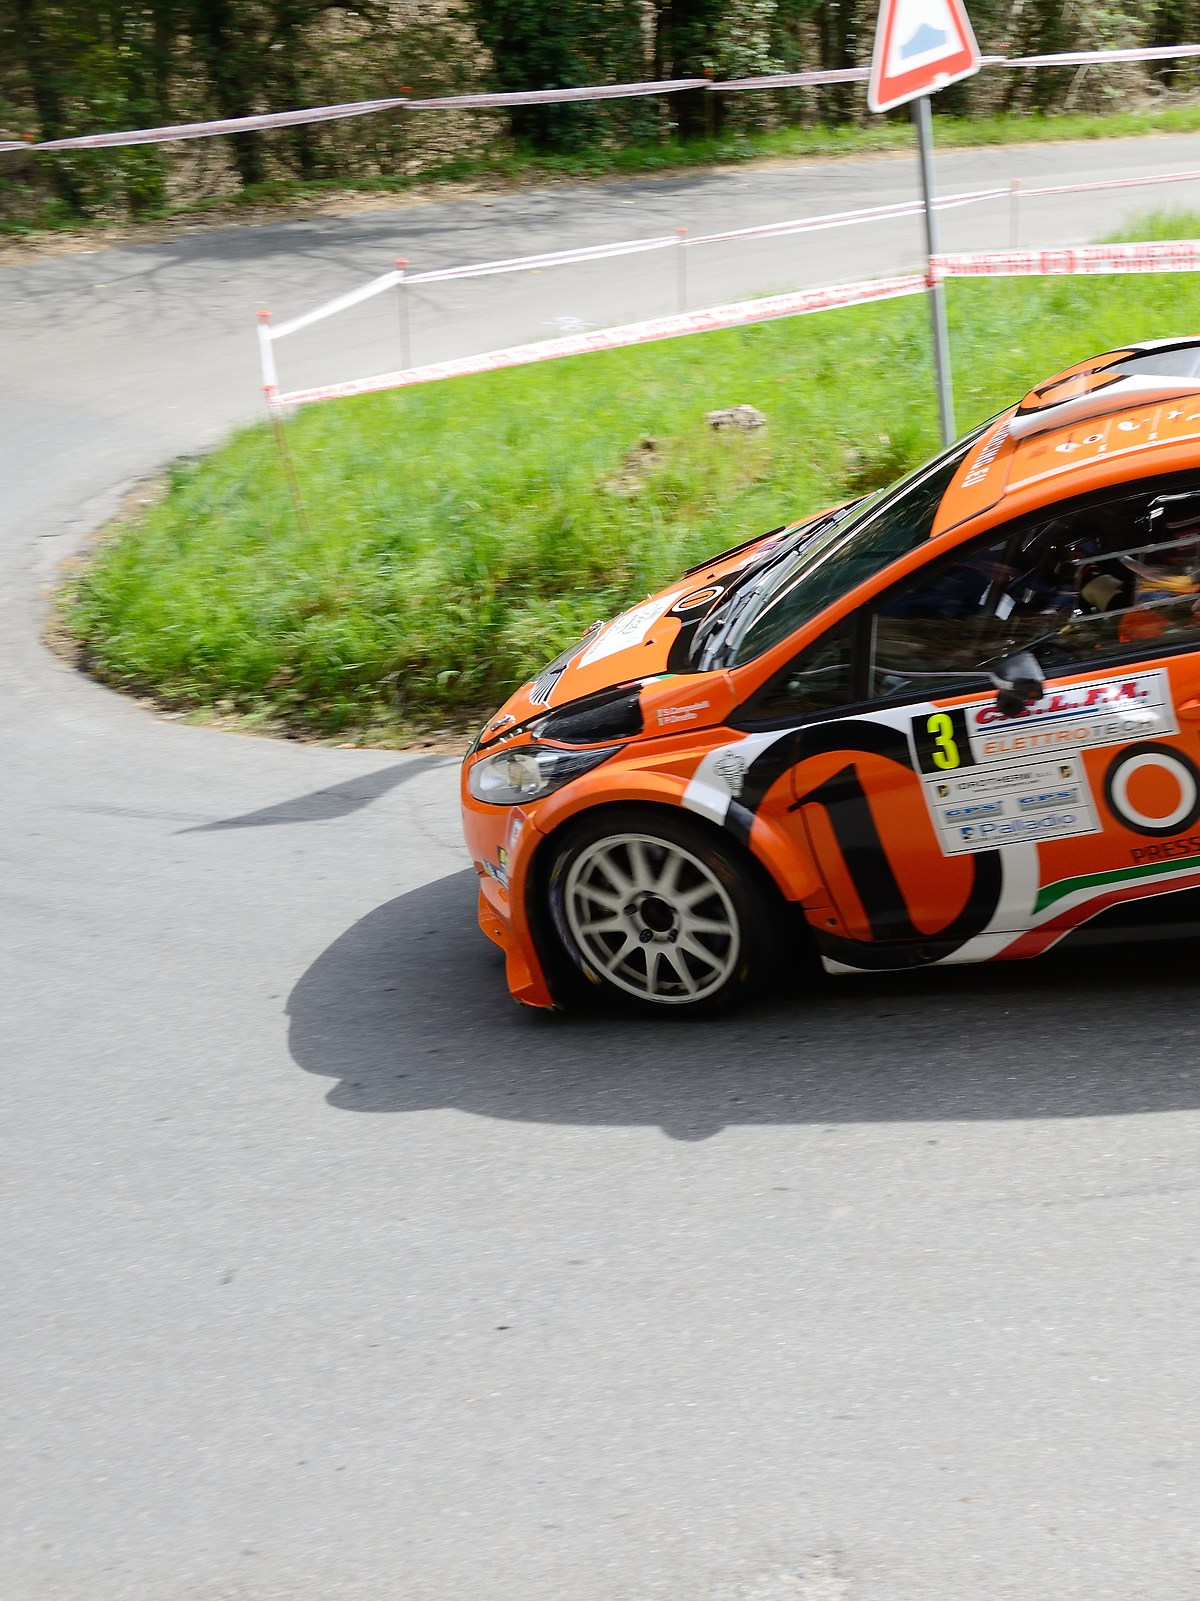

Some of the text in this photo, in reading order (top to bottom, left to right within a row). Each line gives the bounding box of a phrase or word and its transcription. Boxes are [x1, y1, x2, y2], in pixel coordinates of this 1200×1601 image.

[926, 713, 960, 770] 3
[983, 720, 1154, 756] ELETTROTECH
[979, 813, 1077, 836] Palladio
